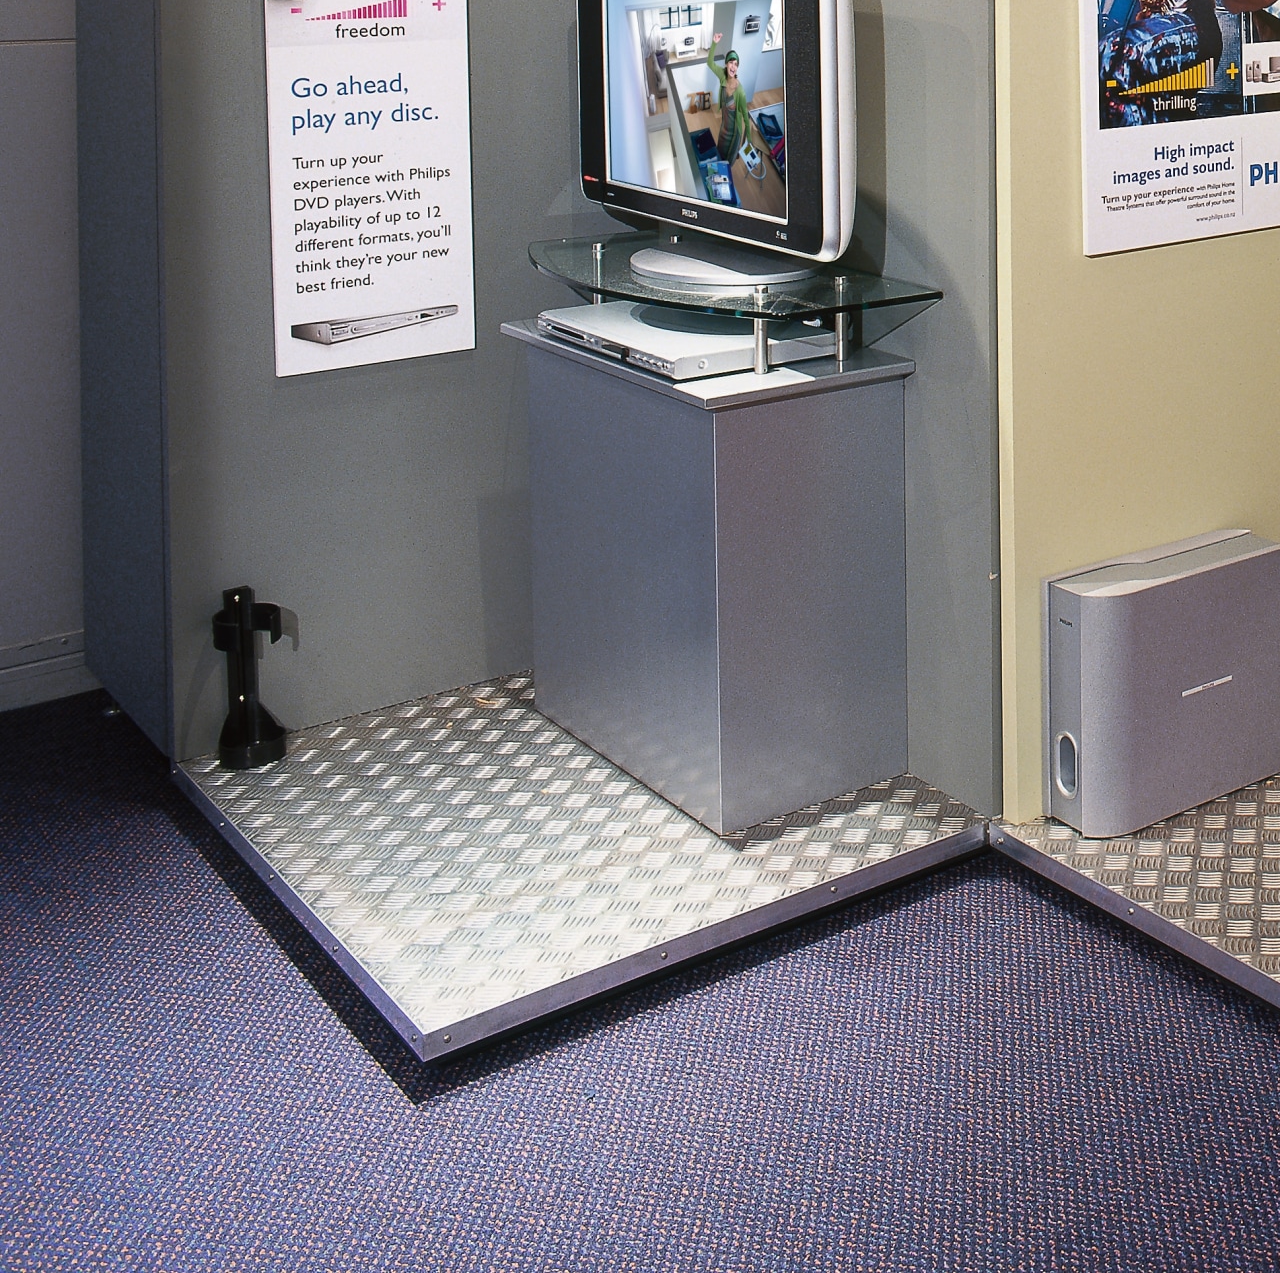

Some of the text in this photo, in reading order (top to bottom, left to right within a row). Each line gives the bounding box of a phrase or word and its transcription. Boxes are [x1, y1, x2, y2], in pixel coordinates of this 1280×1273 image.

[335, 23, 405, 38] freedom
[291, 72, 408, 98] Go ahead,
[1153, 95, 1197, 112] thrilling
[292, 102, 439, 136] play any disc.
[292, 154, 383, 169] Turn up your
[1154, 140, 1235, 163] High impact
[293, 166, 450, 192] experience with Philips
[1113, 156, 1235, 185] images and sound.
[294, 188, 421, 211] DVD players. With
[1101, 195, 1120, 204] Turn
[1122, 194, 1132, 203] up
[1133, 192, 1151, 202] your
[1153, 186, 1195, 198] experience
[1126, 202, 1145, 211] Systems
[1167, 195, 1187, 205] powerful
[1188, 193, 1208, 201] surround
[1186, 201, 1205, 209] comfort
[294, 205, 441, 235] playability of up to 12
[295, 224, 451, 253] different formats, you'll
[295, 247, 449, 274] think they're your new
[296, 273, 375, 294] best friend.
